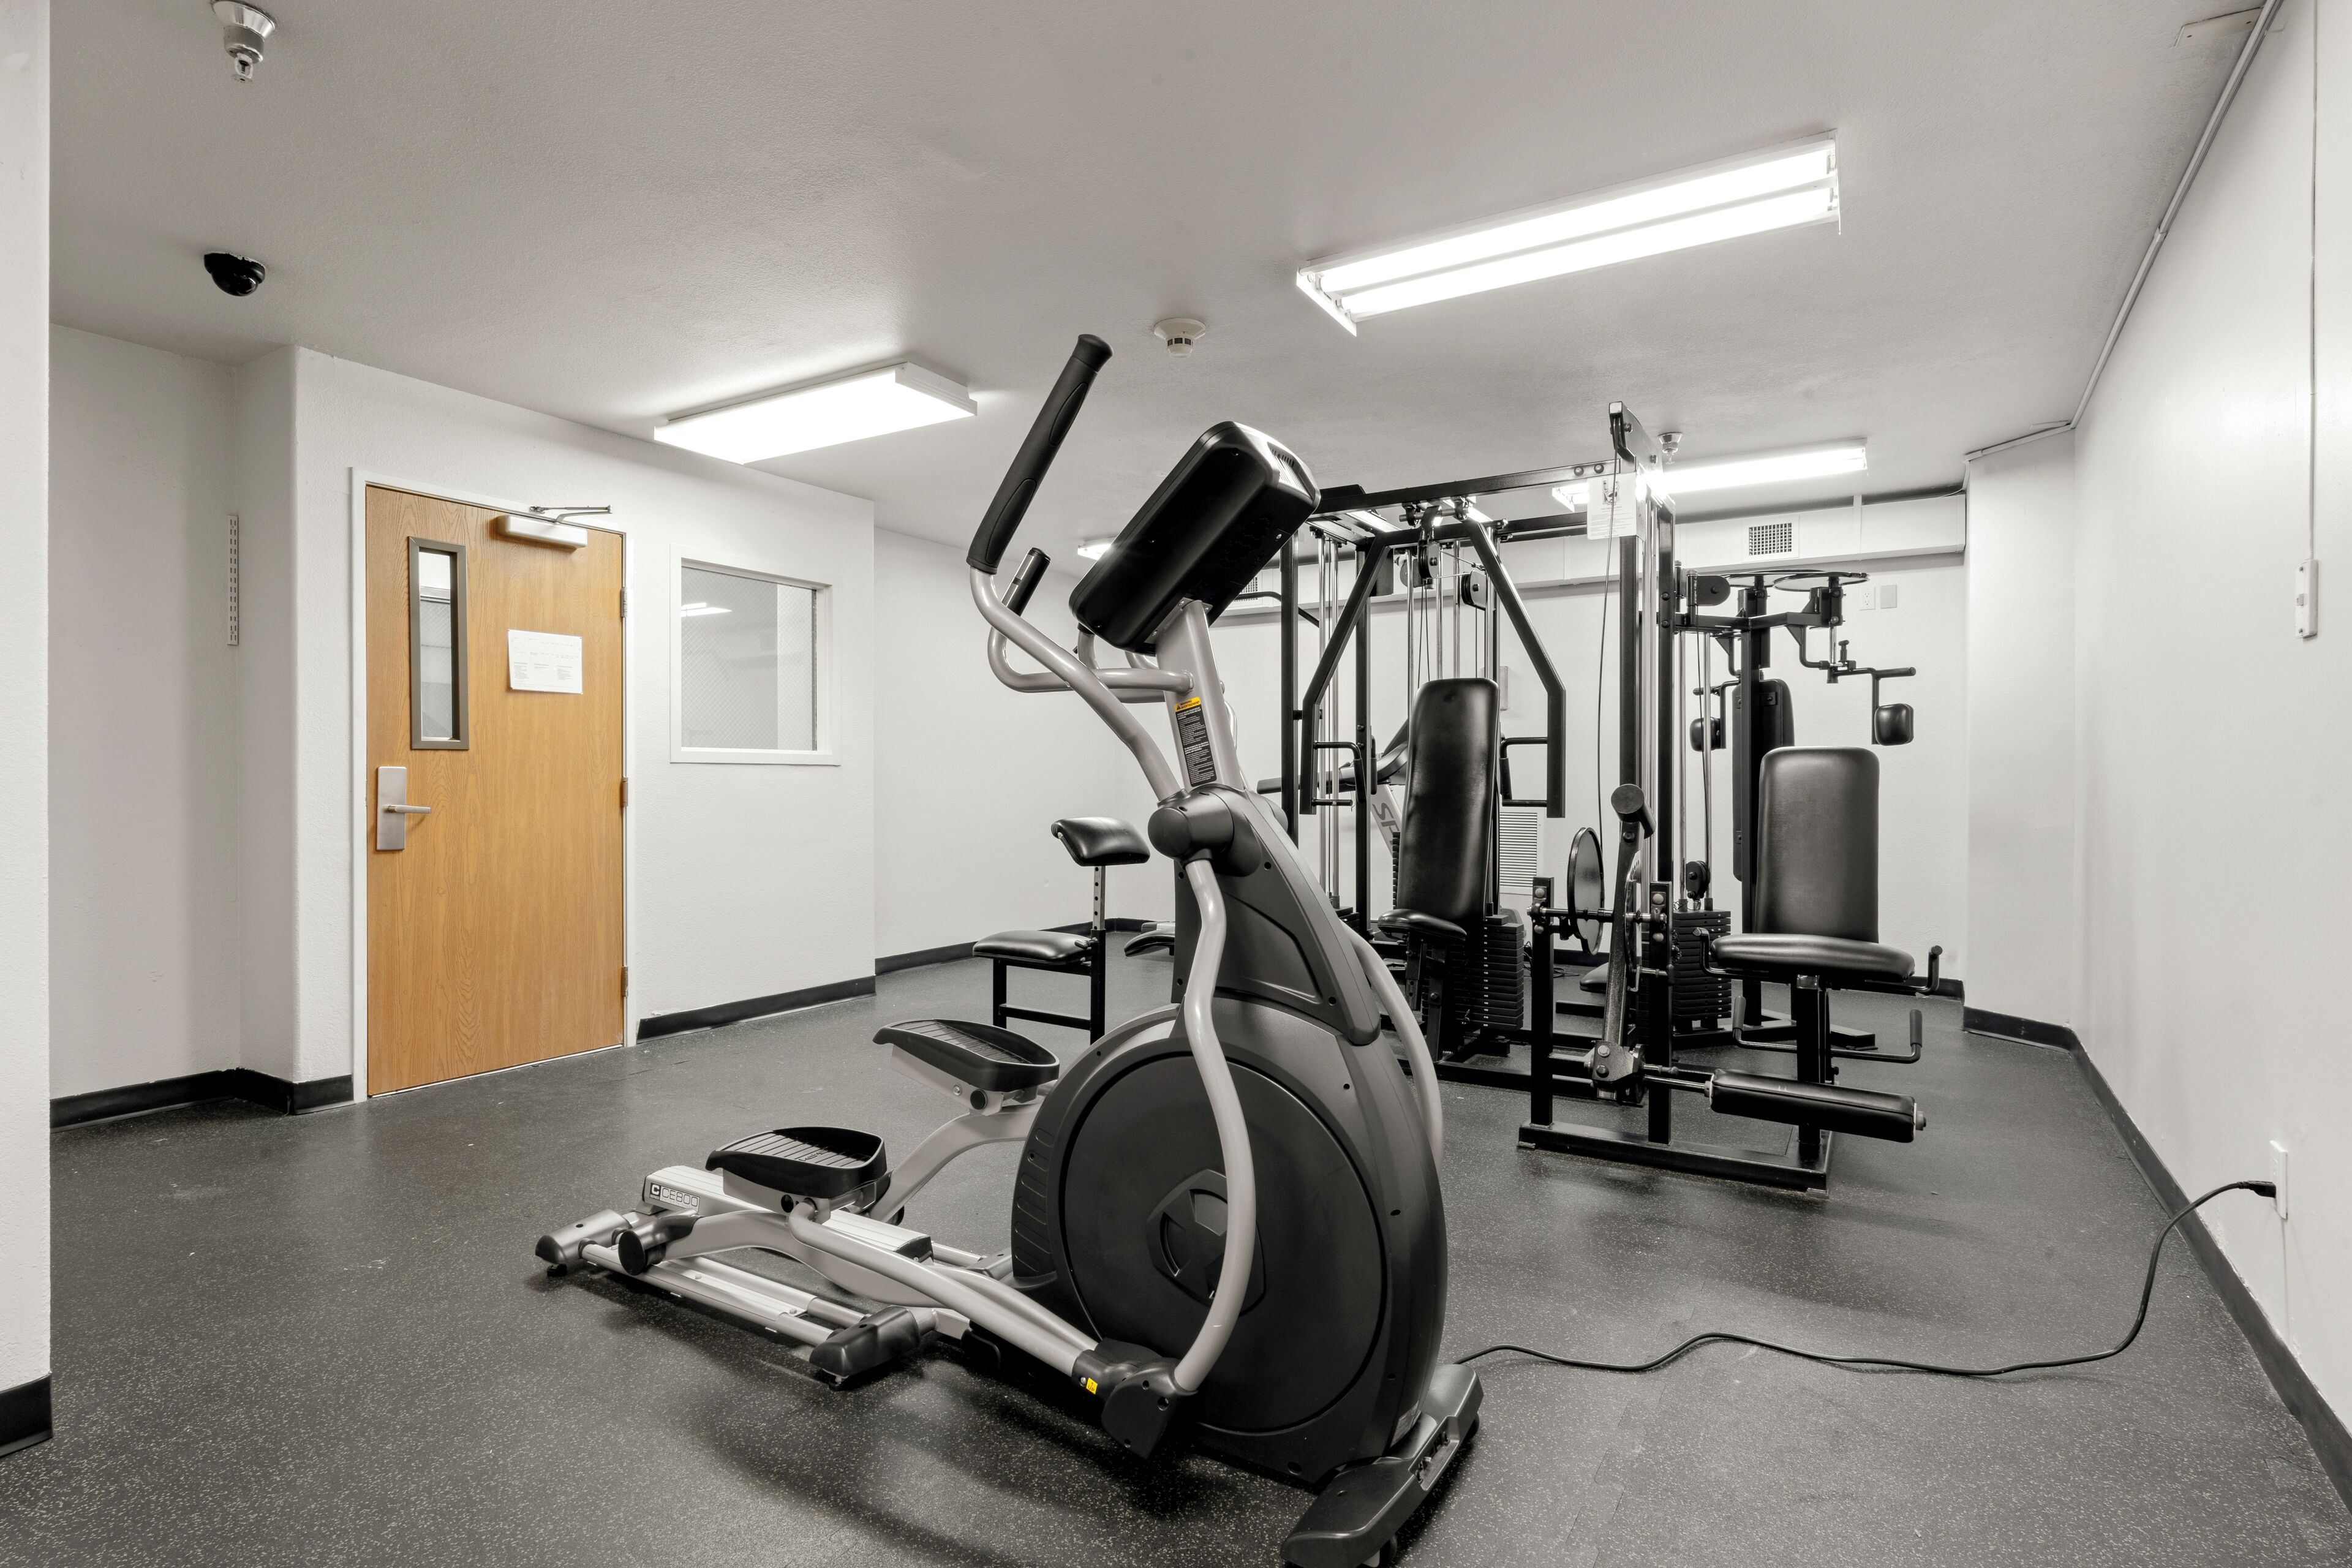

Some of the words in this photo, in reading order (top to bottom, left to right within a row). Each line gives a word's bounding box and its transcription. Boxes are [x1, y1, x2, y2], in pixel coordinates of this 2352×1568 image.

[1372, 802, 1400, 845] SP
[652, 1184, 660, 1195] C
[662, 1188, 698, 1207] CE800
